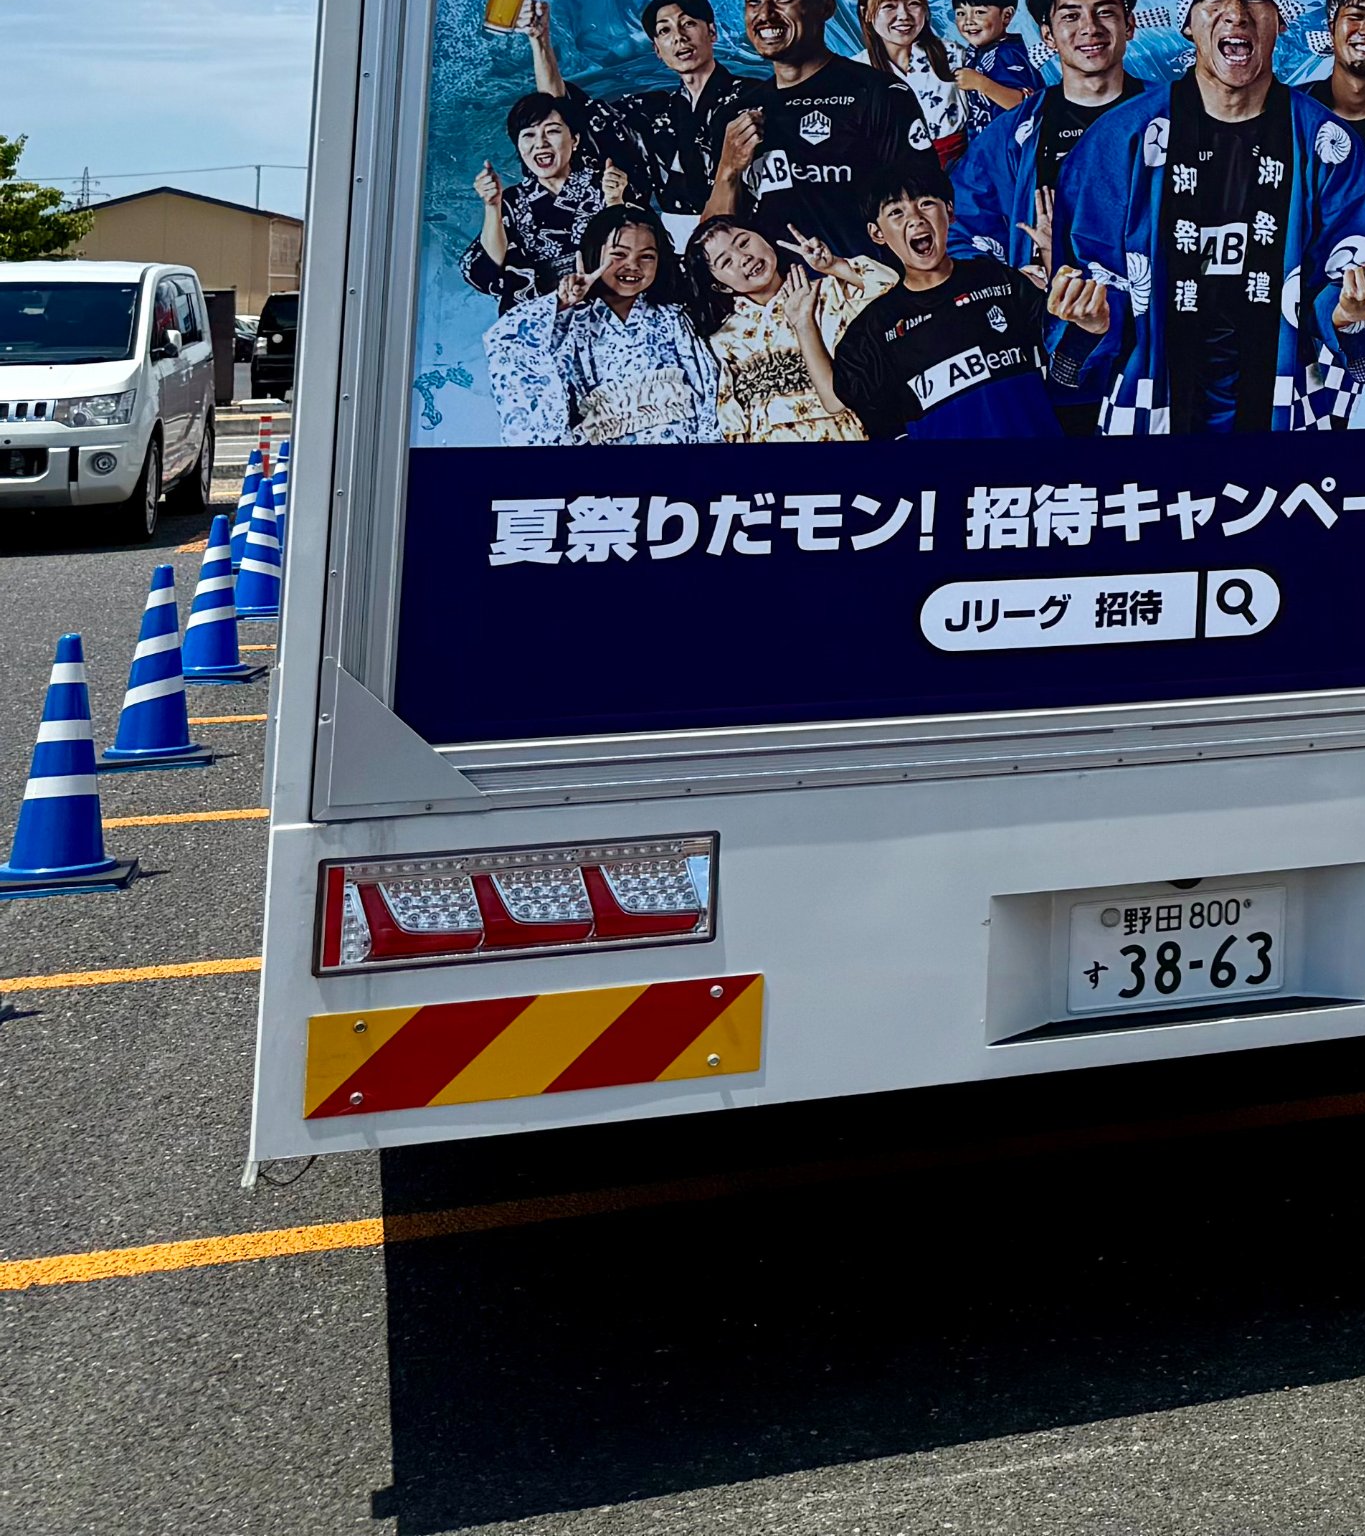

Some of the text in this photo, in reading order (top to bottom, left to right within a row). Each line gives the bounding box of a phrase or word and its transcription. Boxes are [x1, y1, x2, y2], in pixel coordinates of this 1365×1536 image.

[489, 490, 937, 567] 夏祭りだモン!
[943, 590, 1163, 633] Jリーグ 招待
[1123, 898, 1240, 935] 野田 800
[1083, 931, 1273, 999] す 38-63
